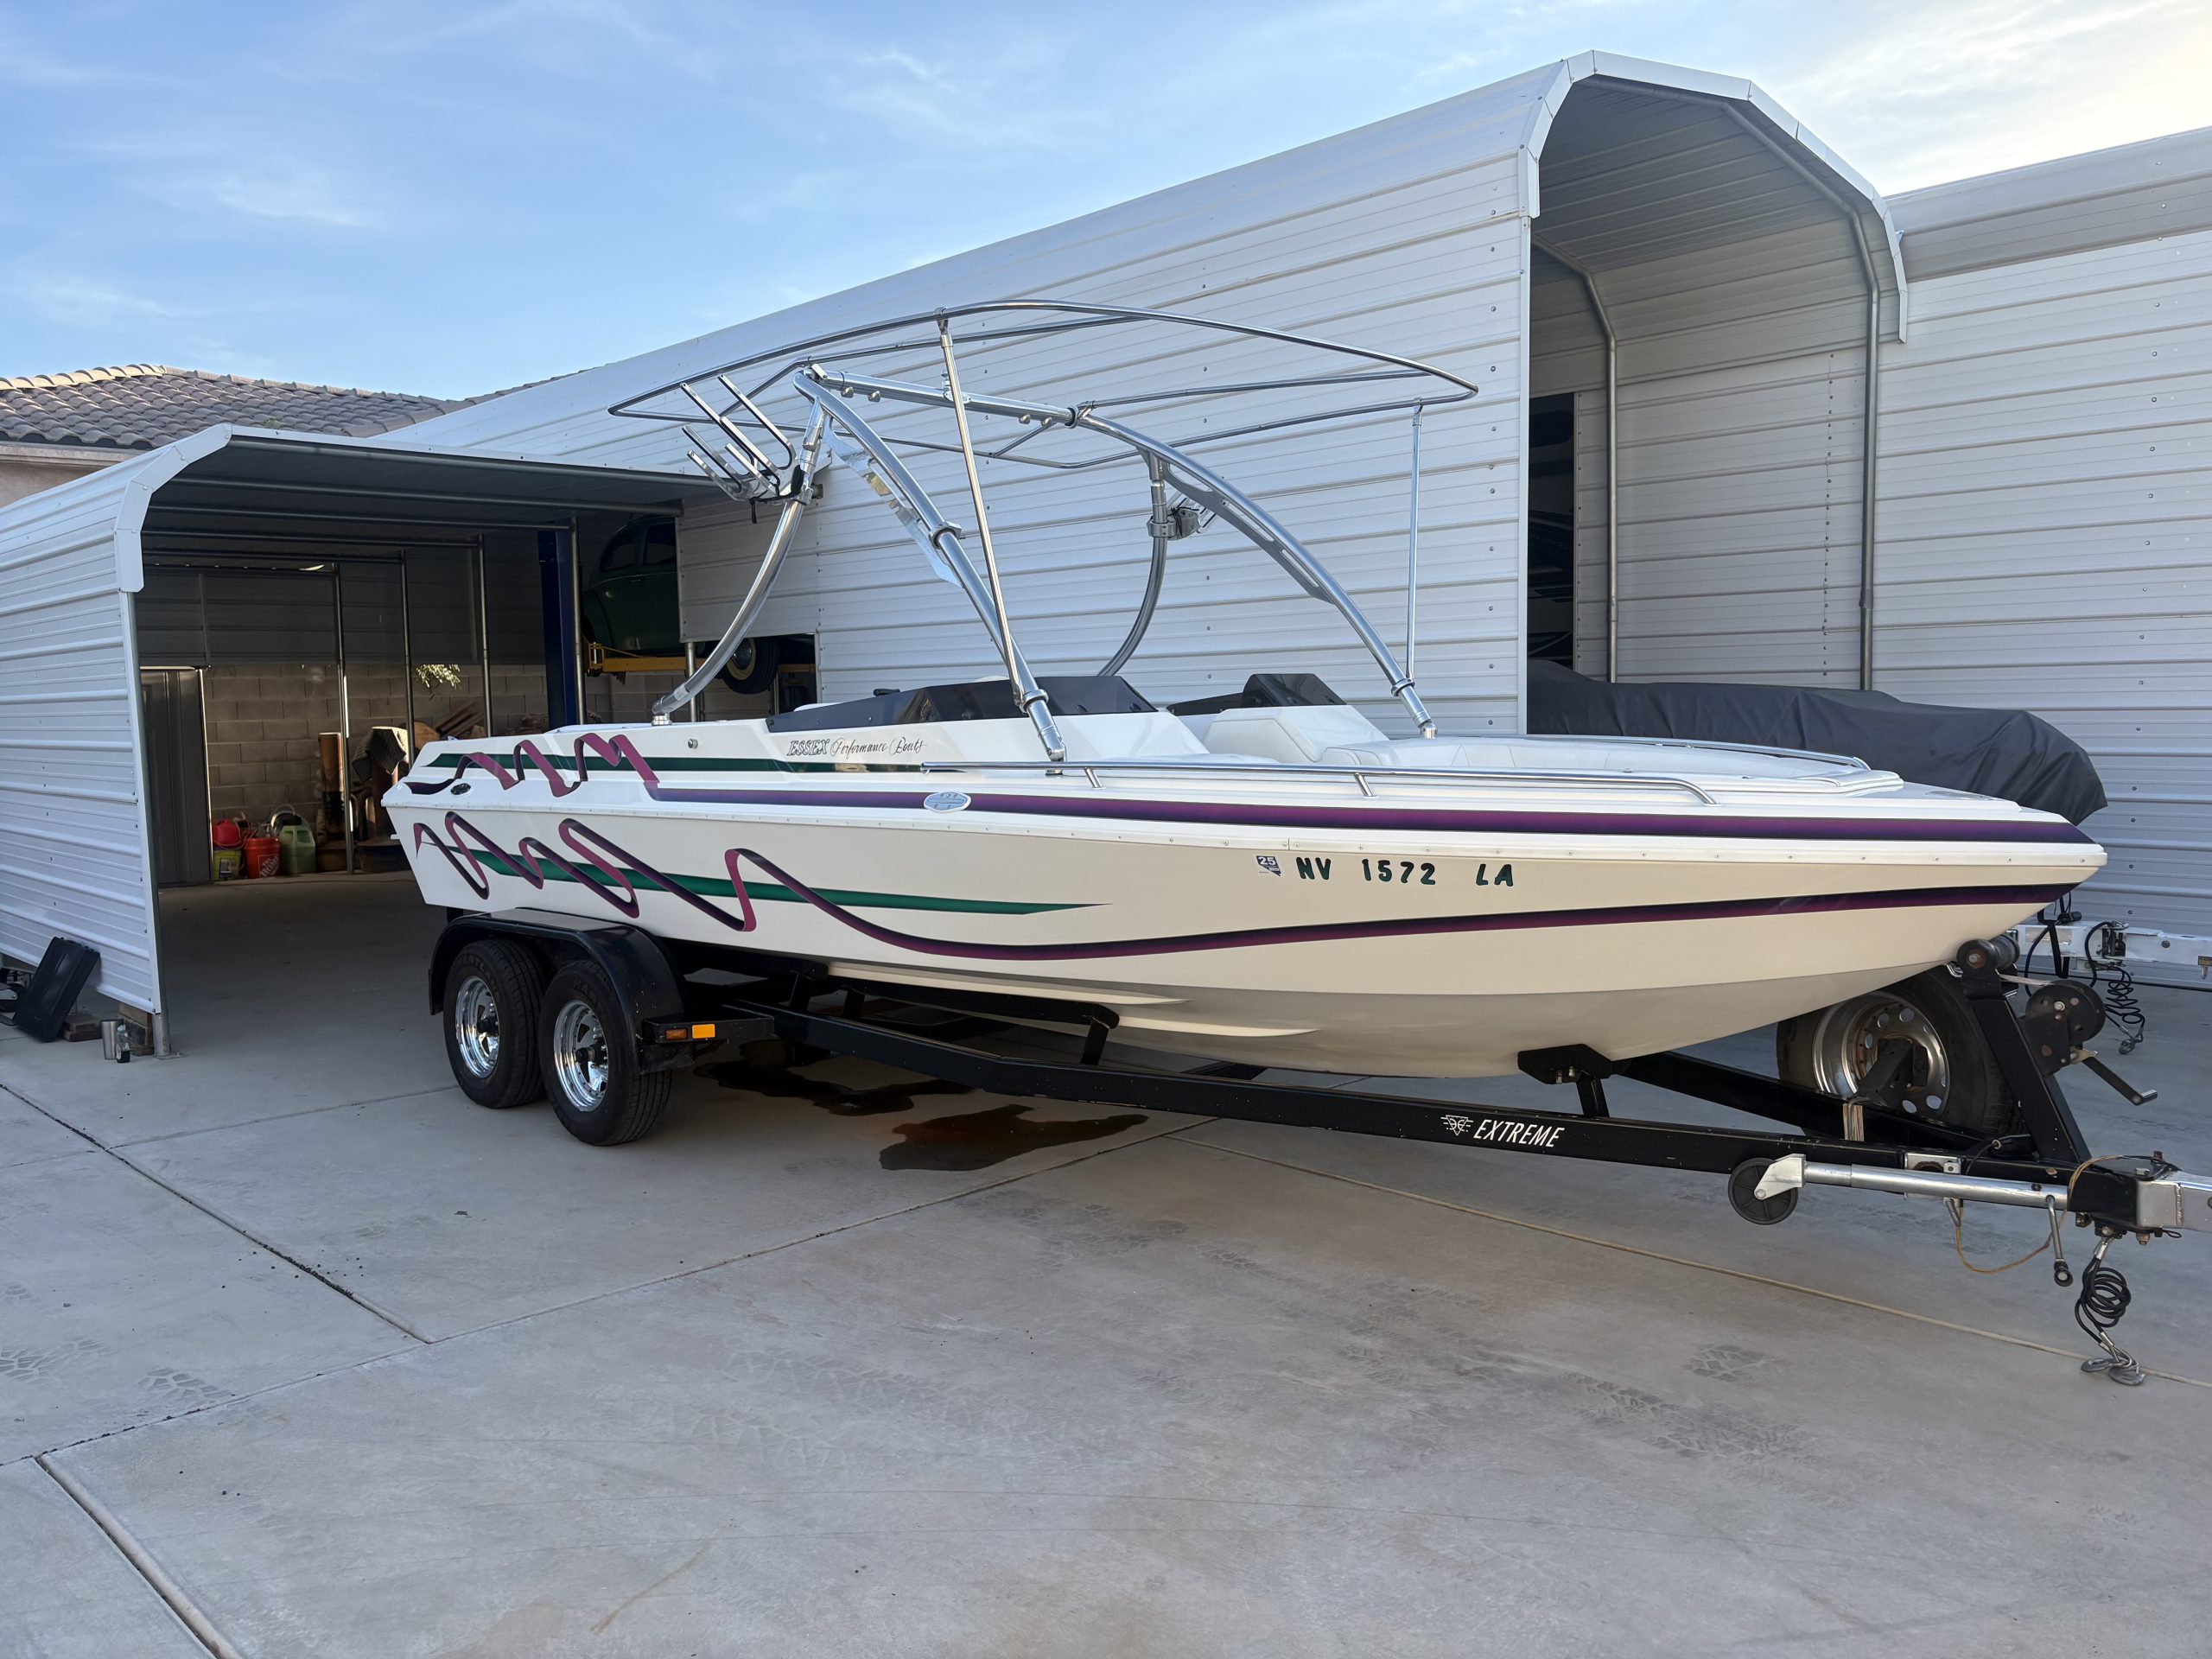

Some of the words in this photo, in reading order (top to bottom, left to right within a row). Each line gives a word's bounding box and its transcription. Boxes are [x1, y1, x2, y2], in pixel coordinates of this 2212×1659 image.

[786, 738, 830, 757] ESSEX
[830, 737, 888, 760] Performance
[889, 736, 927, 756] Boats
[1258, 856, 1276, 866] 25
[1296, 856, 1332, 880] NV
[1362, 859, 1436, 886] 1572
[1476, 863, 1514, 887] LA
[1472, 1119, 1566, 1147] EXTREME
